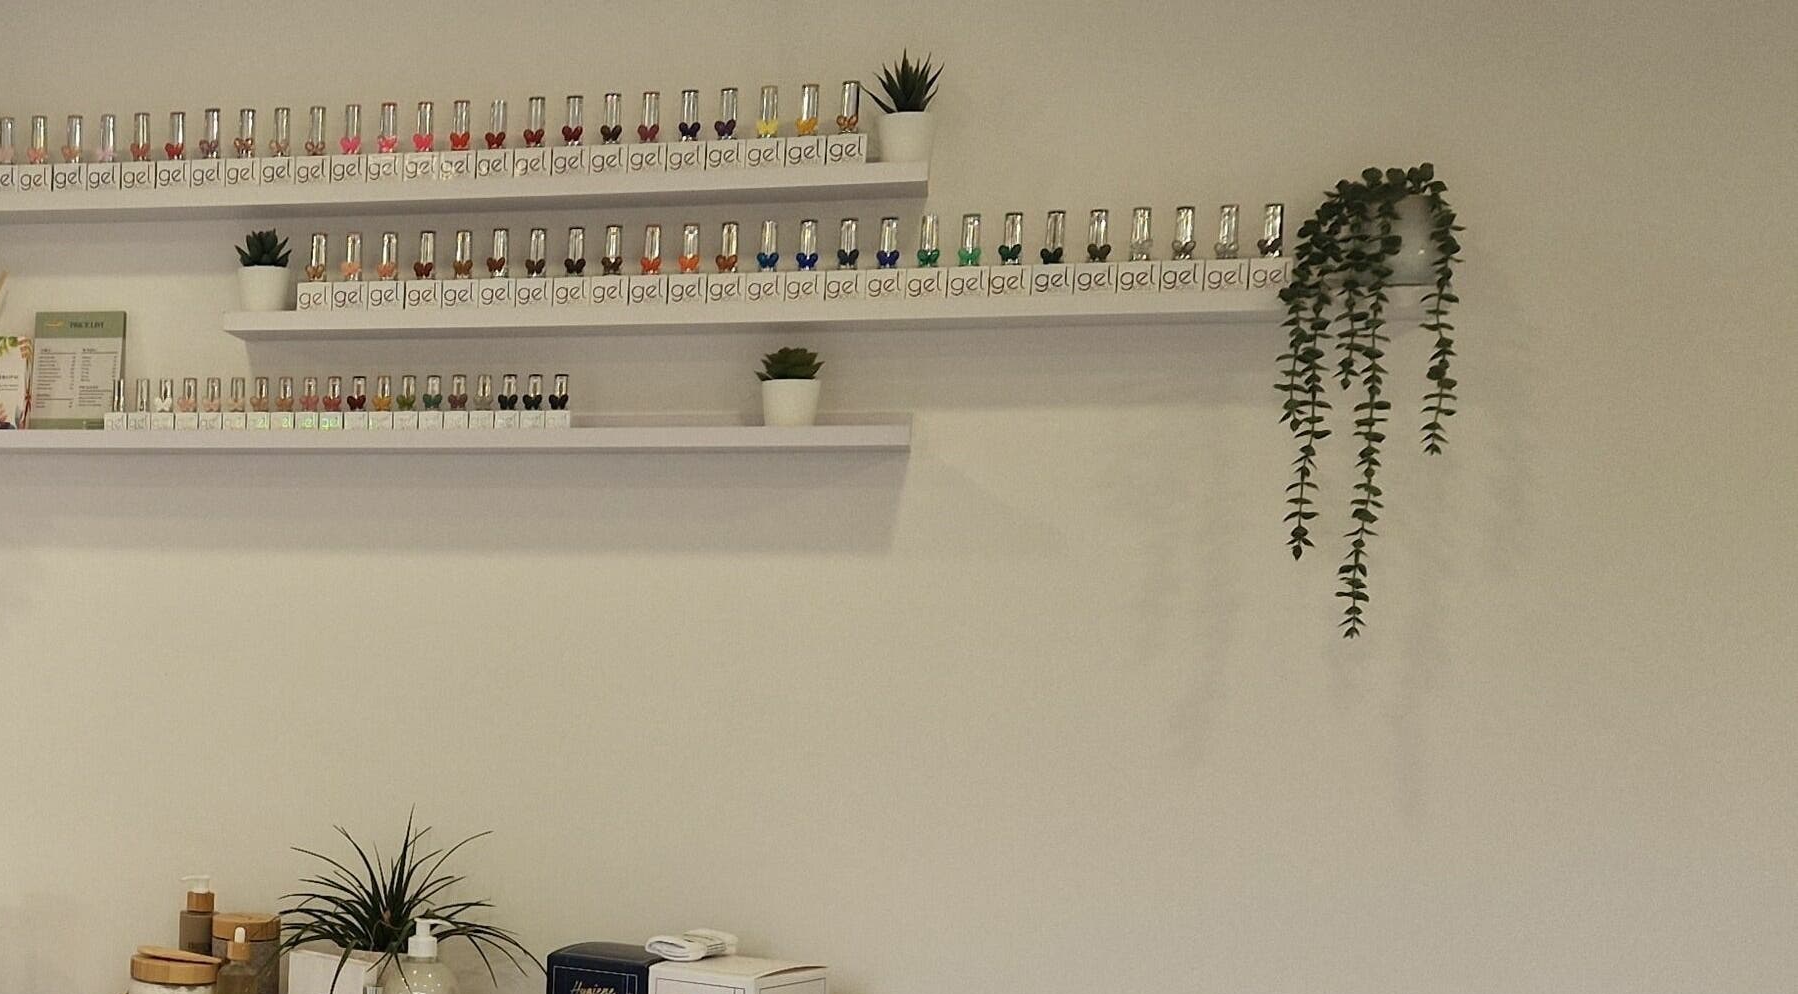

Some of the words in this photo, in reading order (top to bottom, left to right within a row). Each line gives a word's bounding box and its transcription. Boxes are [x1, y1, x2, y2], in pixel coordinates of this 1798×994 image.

[591, 147, 623, 173] gel
[630, 146, 662, 171] gel
[668, 145, 700, 170] gel
[708, 142, 740, 168] gel
[747, 140, 780, 167] gel
[788, 139, 821, 165] gel
[829, 136, 862, 161] gel
[192, 161, 220, 187] gel
[226, 160, 256, 185] gel
[262, 159, 291, 184] gel
[297, 158, 326, 183] gel
[332, 157, 361, 182] gel
[368, 155, 398, 181] gel
[405, 154, 435, 179] gel
[478, 152, 508, 177] gel
[515, 150, 546, 176] gel
[554, 149, 584, 174] gel
[20, 167, 49, 190] gel
[55, 166, 83, 189] gel
[89, 165, 117, 189] gel
[123, 164, 151, 189] gel
[158, 162, 187, 187] gel
[786, 274, 818, 300] gel
[826, 273, 858, 299] gel
[867, 271, 900, 297] gel
[907, 270, 941, 297] gel
[950, 269, 983, 296] gel
[991, 268, 1025, 295] gel
[1034, 266, 1069, 293] gel
[1077, 265, 1111, 292] gel
[1120, 264, 1155, 291] gel
[1162, 262, 1199, 289] gel
[1207, 263, 1243, 289] gel
[1251, 261, 1289, 288] gel
[299, 286, 327, 309] gel
[333, 284, 363, 308] gel
[370, 282, 400, 307] gel
[407, 282, 437, 307] gel
[443, 282, 473, 307] gel
[480, 280, 511, 306] gel
[517, 280, 548, 305] gel
[555, 280, 586, 305] gel
[592, 279, 623, 304] gel
[631, 278, 662, 304] gel
[670, 276, 702, 302] gel
[709, 276, 741, 301] gel
[747, 275, 779, 301] gel
